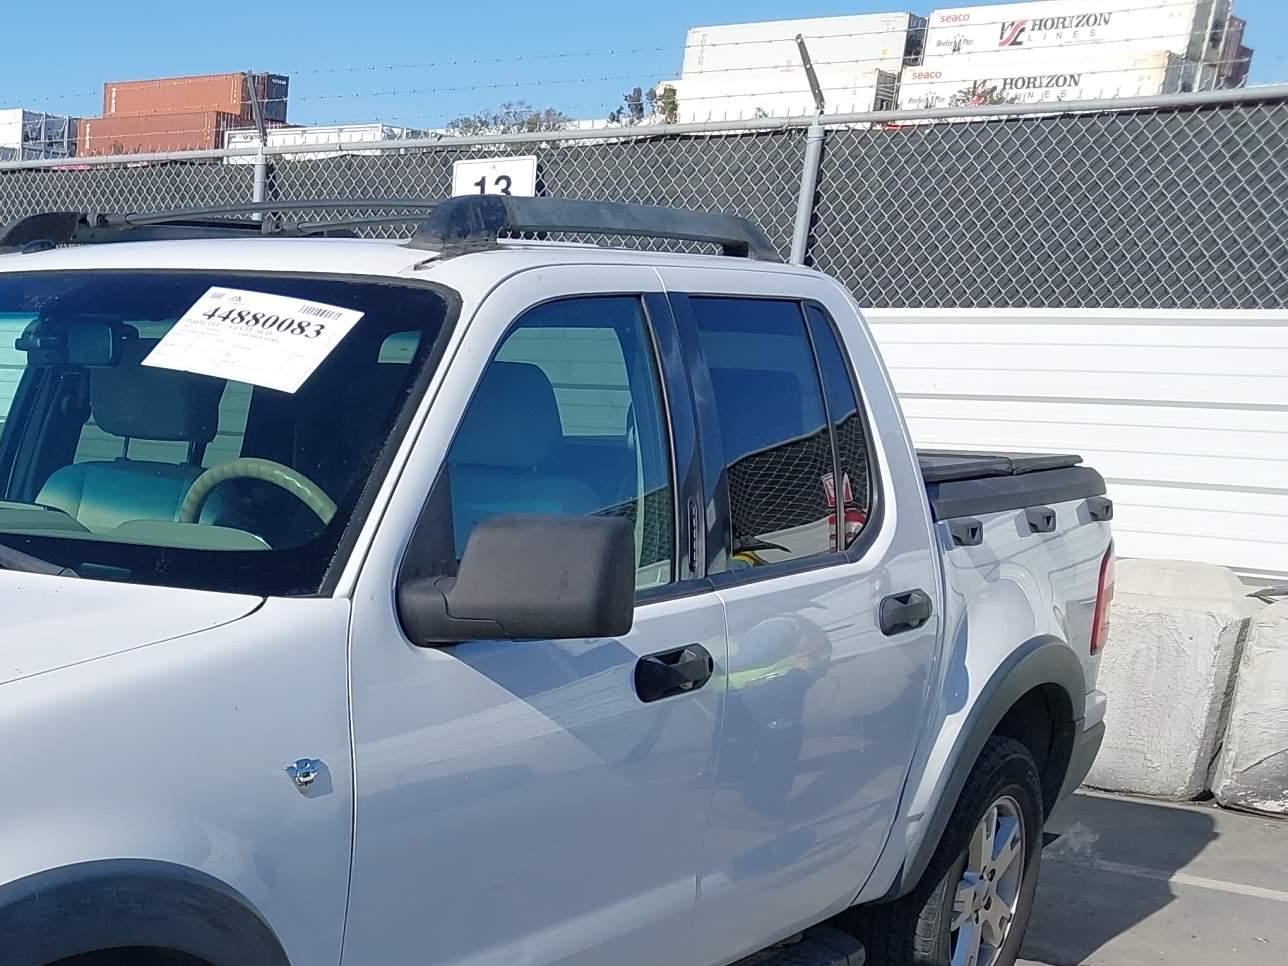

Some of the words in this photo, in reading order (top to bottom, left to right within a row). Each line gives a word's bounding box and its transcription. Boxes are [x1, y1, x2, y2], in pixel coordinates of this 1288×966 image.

[939, 13, 970, 23] seaco
[1030, 12, 1112, 32] HORIZON
[1027, 29, 1096, 42] LINES
[911, 70, 942, 80] seaco
[1002, 73, 1081, 90] HORIZON
[473, 174, 512, 196] 13
[202, 305, 326, 340] 44880083
